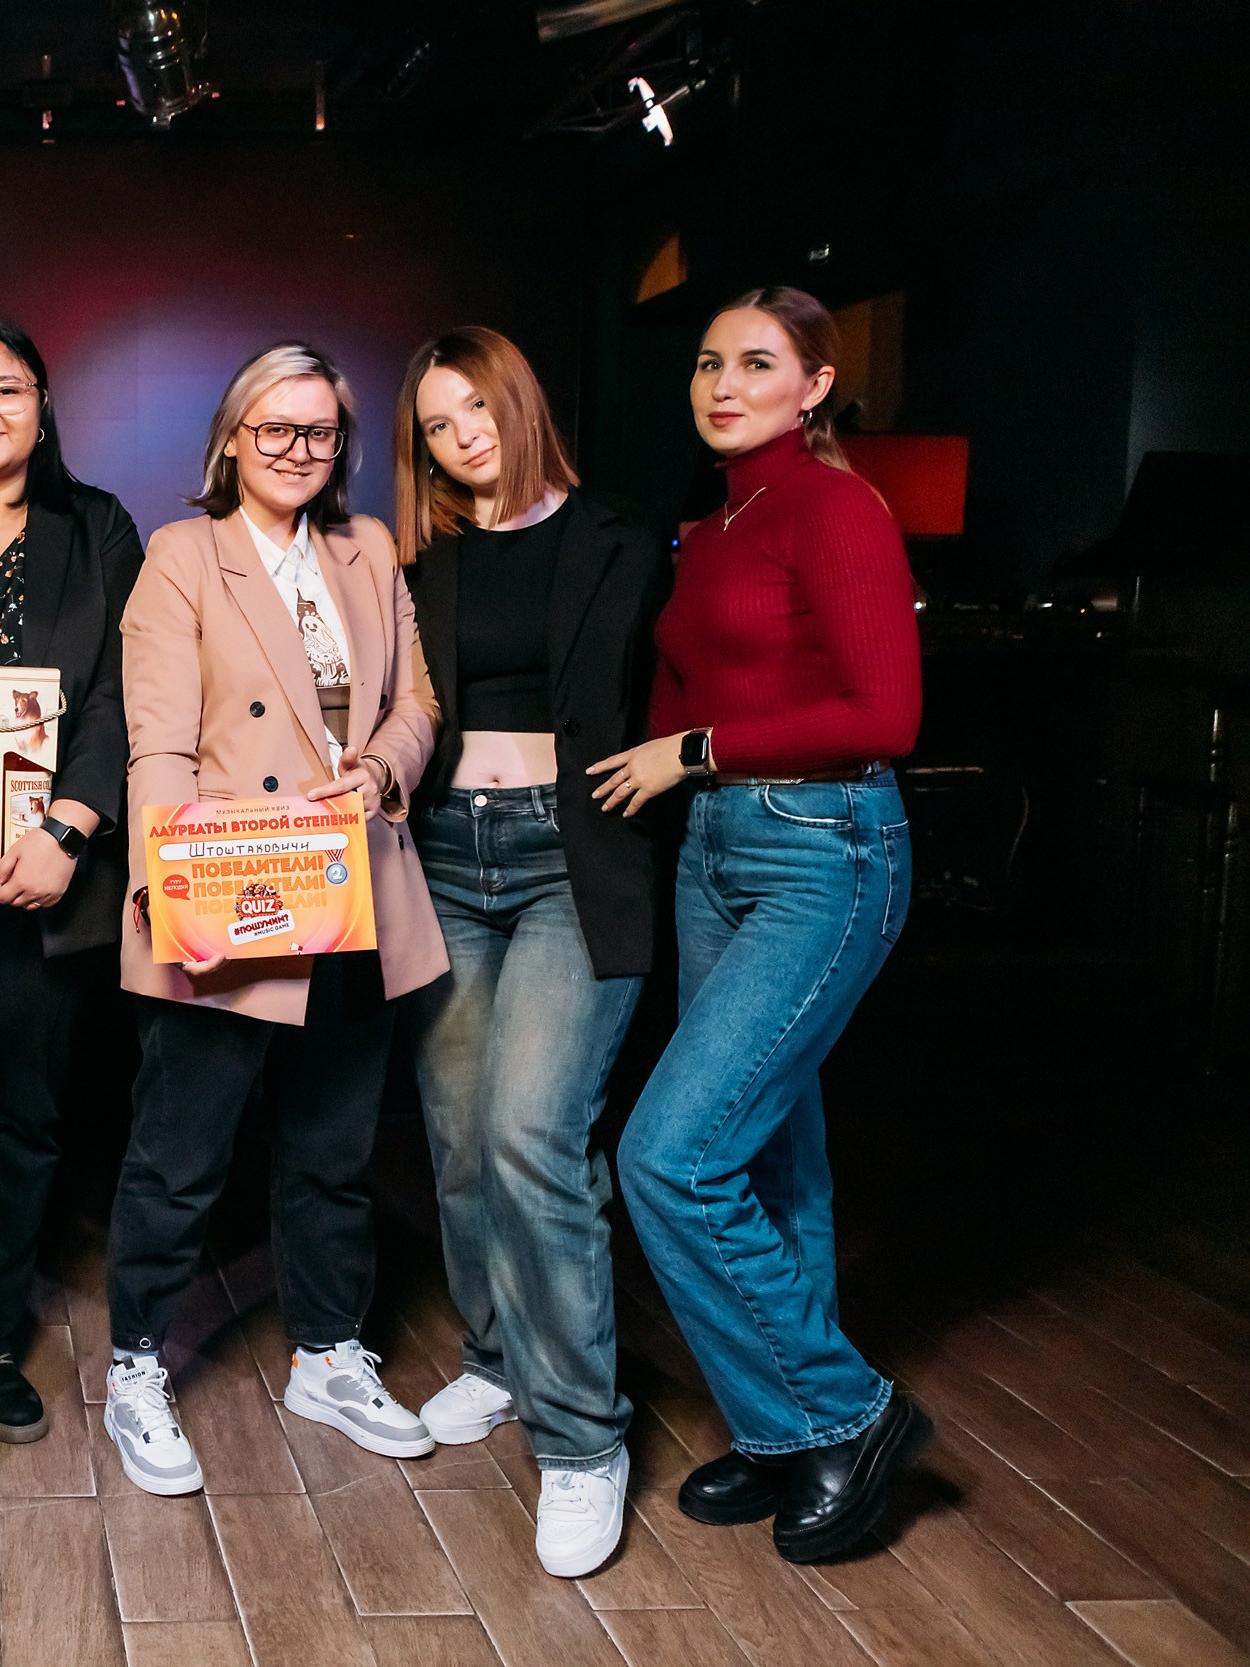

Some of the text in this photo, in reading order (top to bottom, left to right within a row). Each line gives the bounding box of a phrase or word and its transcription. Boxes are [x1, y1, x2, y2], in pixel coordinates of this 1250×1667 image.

[10, 779, 43, 792] SCOTTISH
[216, 805, 269, 814] МУЗЫКАЛЬНЫЙ
[149, 813, 359, 838] ЛАУРЕАТЫ ВТОРОЙ СТЕПЕНИ
[191, 855, 324, 879] ПОБЕДИТЕЛИ!
[331, 867, 343, 880] 2
[241, 898, 276, 915] QUIZ
